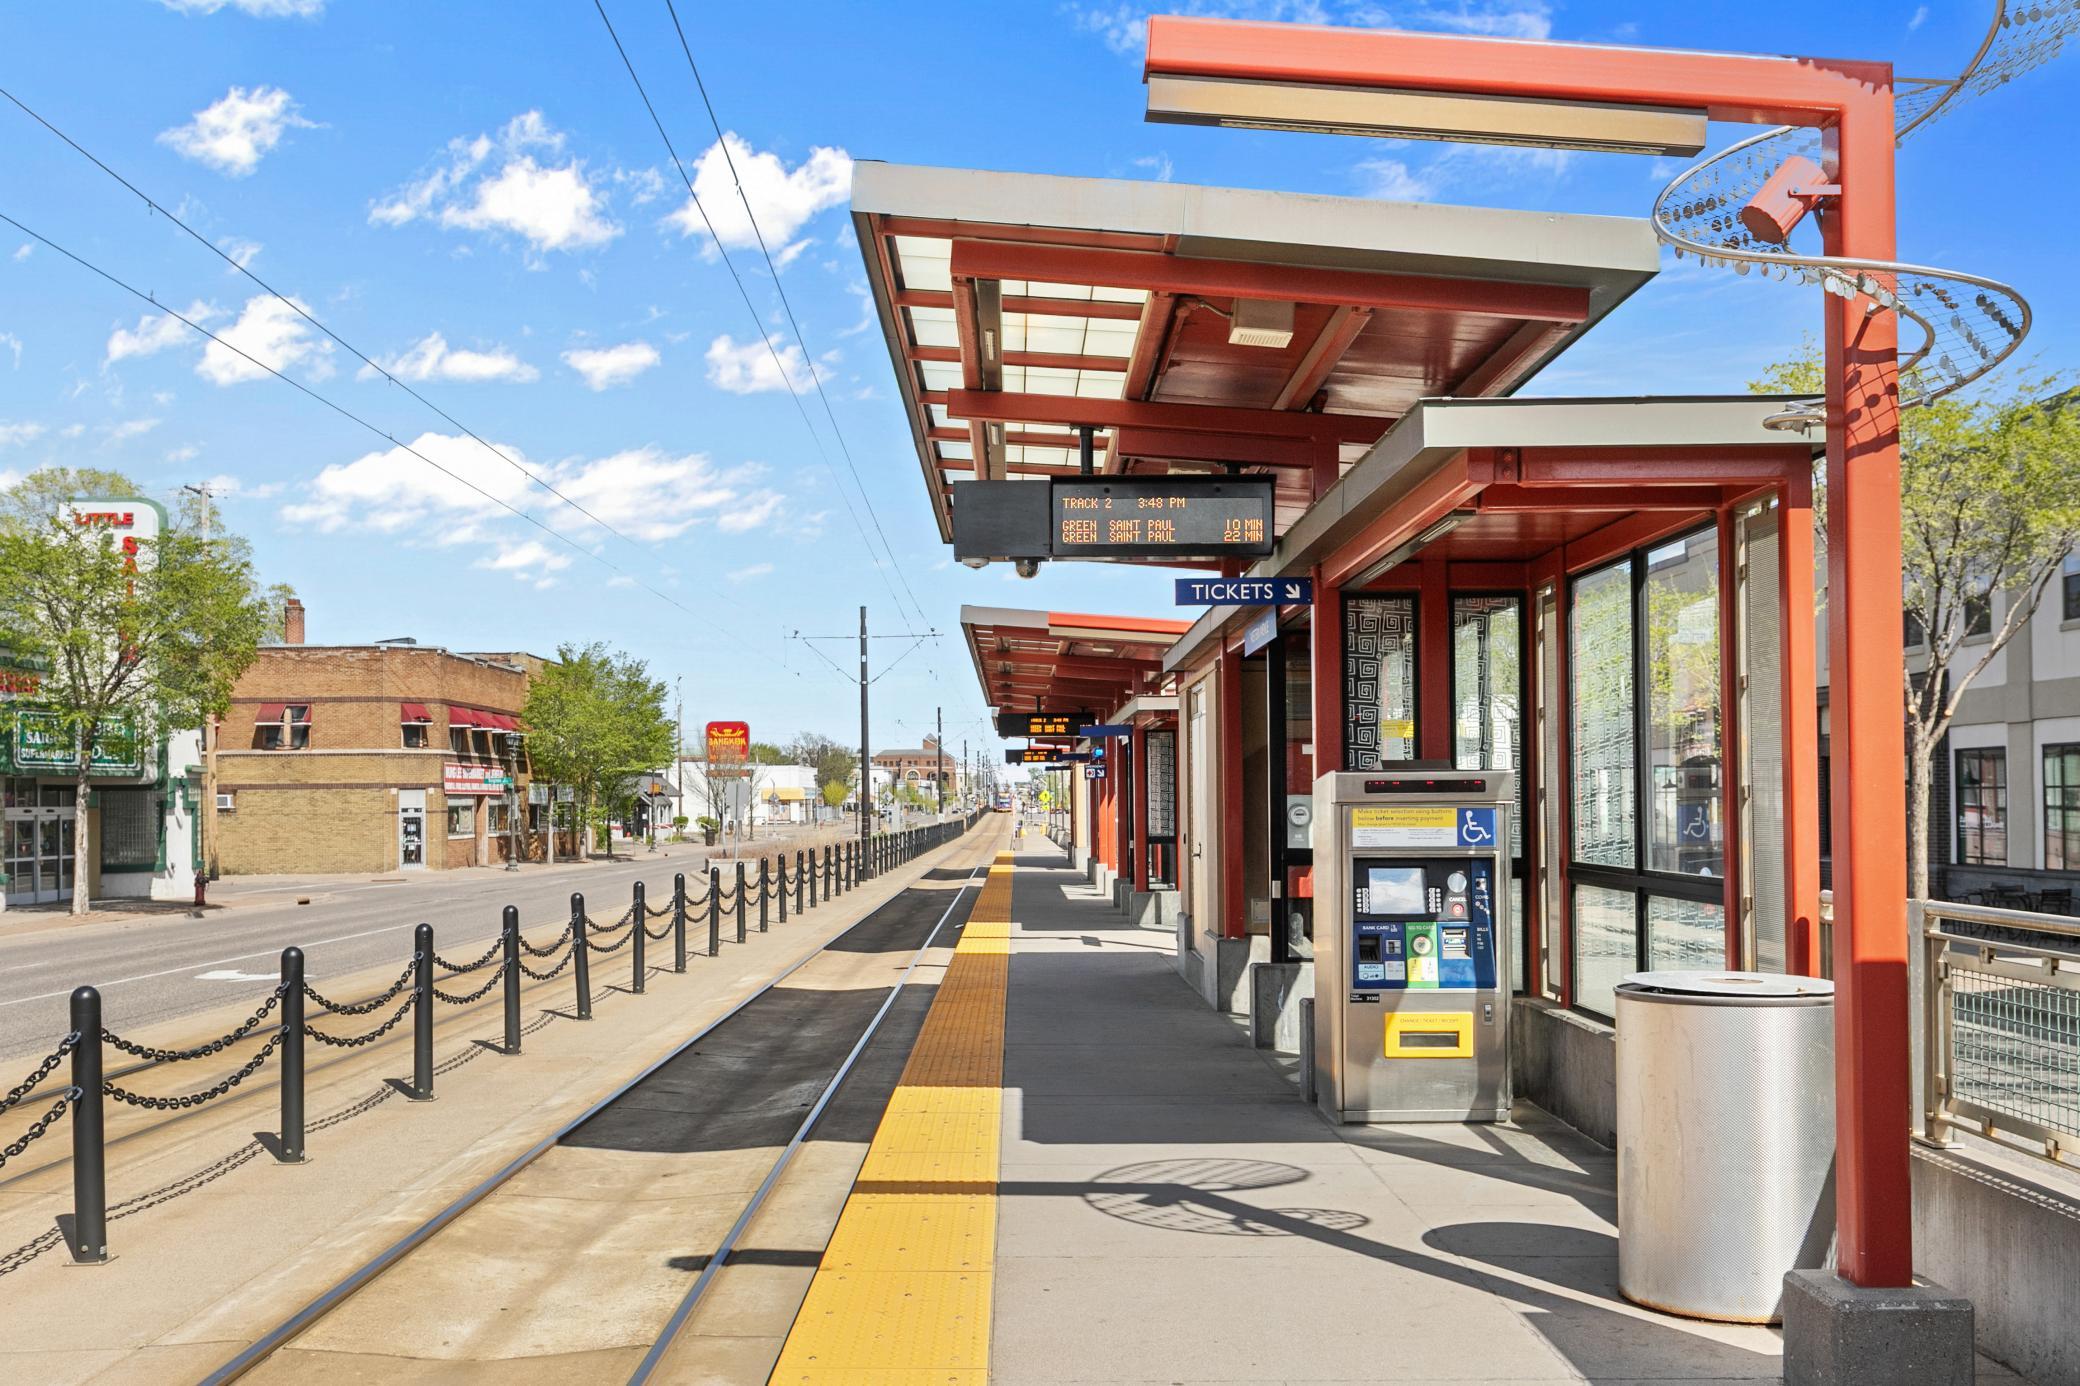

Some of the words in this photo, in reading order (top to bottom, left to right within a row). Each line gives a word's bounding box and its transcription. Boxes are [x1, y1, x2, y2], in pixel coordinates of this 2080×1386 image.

[1062, 498, 1098, 509] TRACK
[1105, 498, 1112, 509] 2
[1138, 498, 1163, 509] 3:48
[1169, 498, 1185, 508] PM
[74, 512, 134, 526] LITTLE
[1062, 520, 1097, 531] GREEN
[1109, 520, 1140, 531] SAINT
[1148, 520, 1175, 531] PAUL
[1226, 519, 1240, 530] 10
[1244, 519, 1263, 530] MIN
[1062, 531, 1097, 542] GREEN
[1109, 531, 1140, 542] SAINT
[1148, 531, 1175, 542] PAUL
[1224, 531, 1240, 542] 22
[1245, 531, 1263, 542] MIN
[1191, 583, 1274, 600] TICKETS
